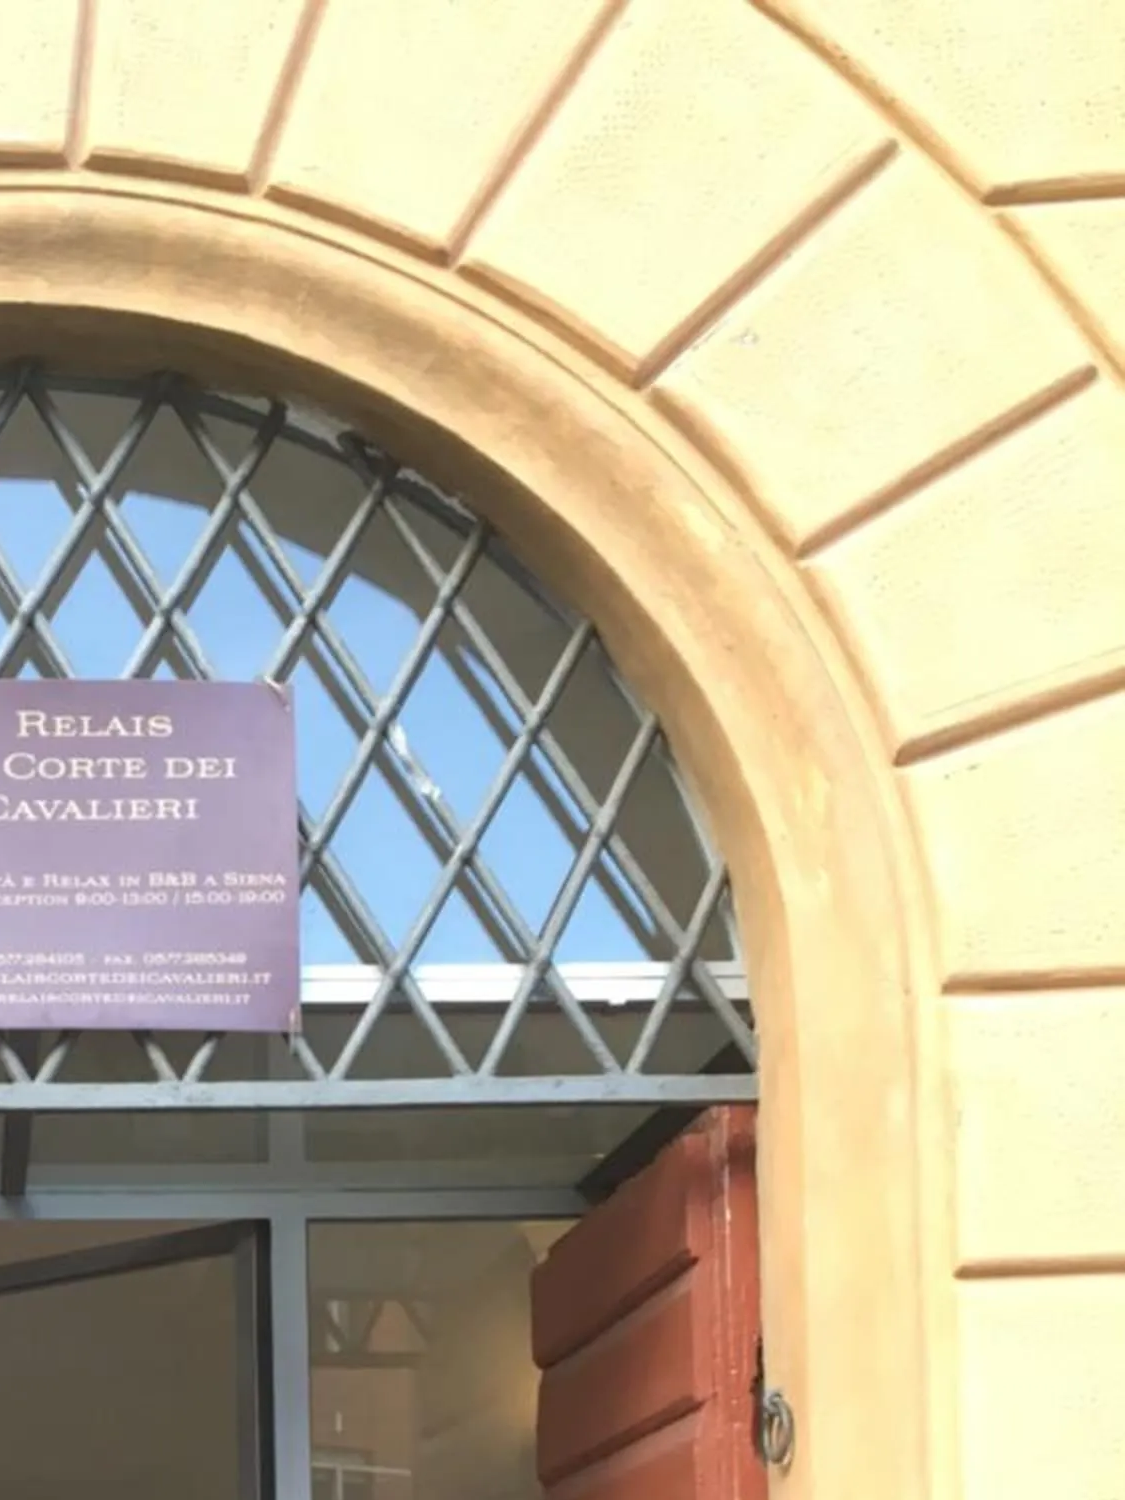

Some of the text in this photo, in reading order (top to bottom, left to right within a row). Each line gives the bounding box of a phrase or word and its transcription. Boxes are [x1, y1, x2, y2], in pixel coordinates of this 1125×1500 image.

[16, 709, 174, 738] RELAIS
[2, 752, 148, 780] CORTE
[163, 756, 237, 779] DEI
[21, 875, 36, 888] E
[42, 872, 110, 888] RELAX
[118, 875, 141, 888] IN
[148, 871, 197, 887] B&B
[203, 874, 218, 887] A
[223, 871, 287, 887] SIENA
